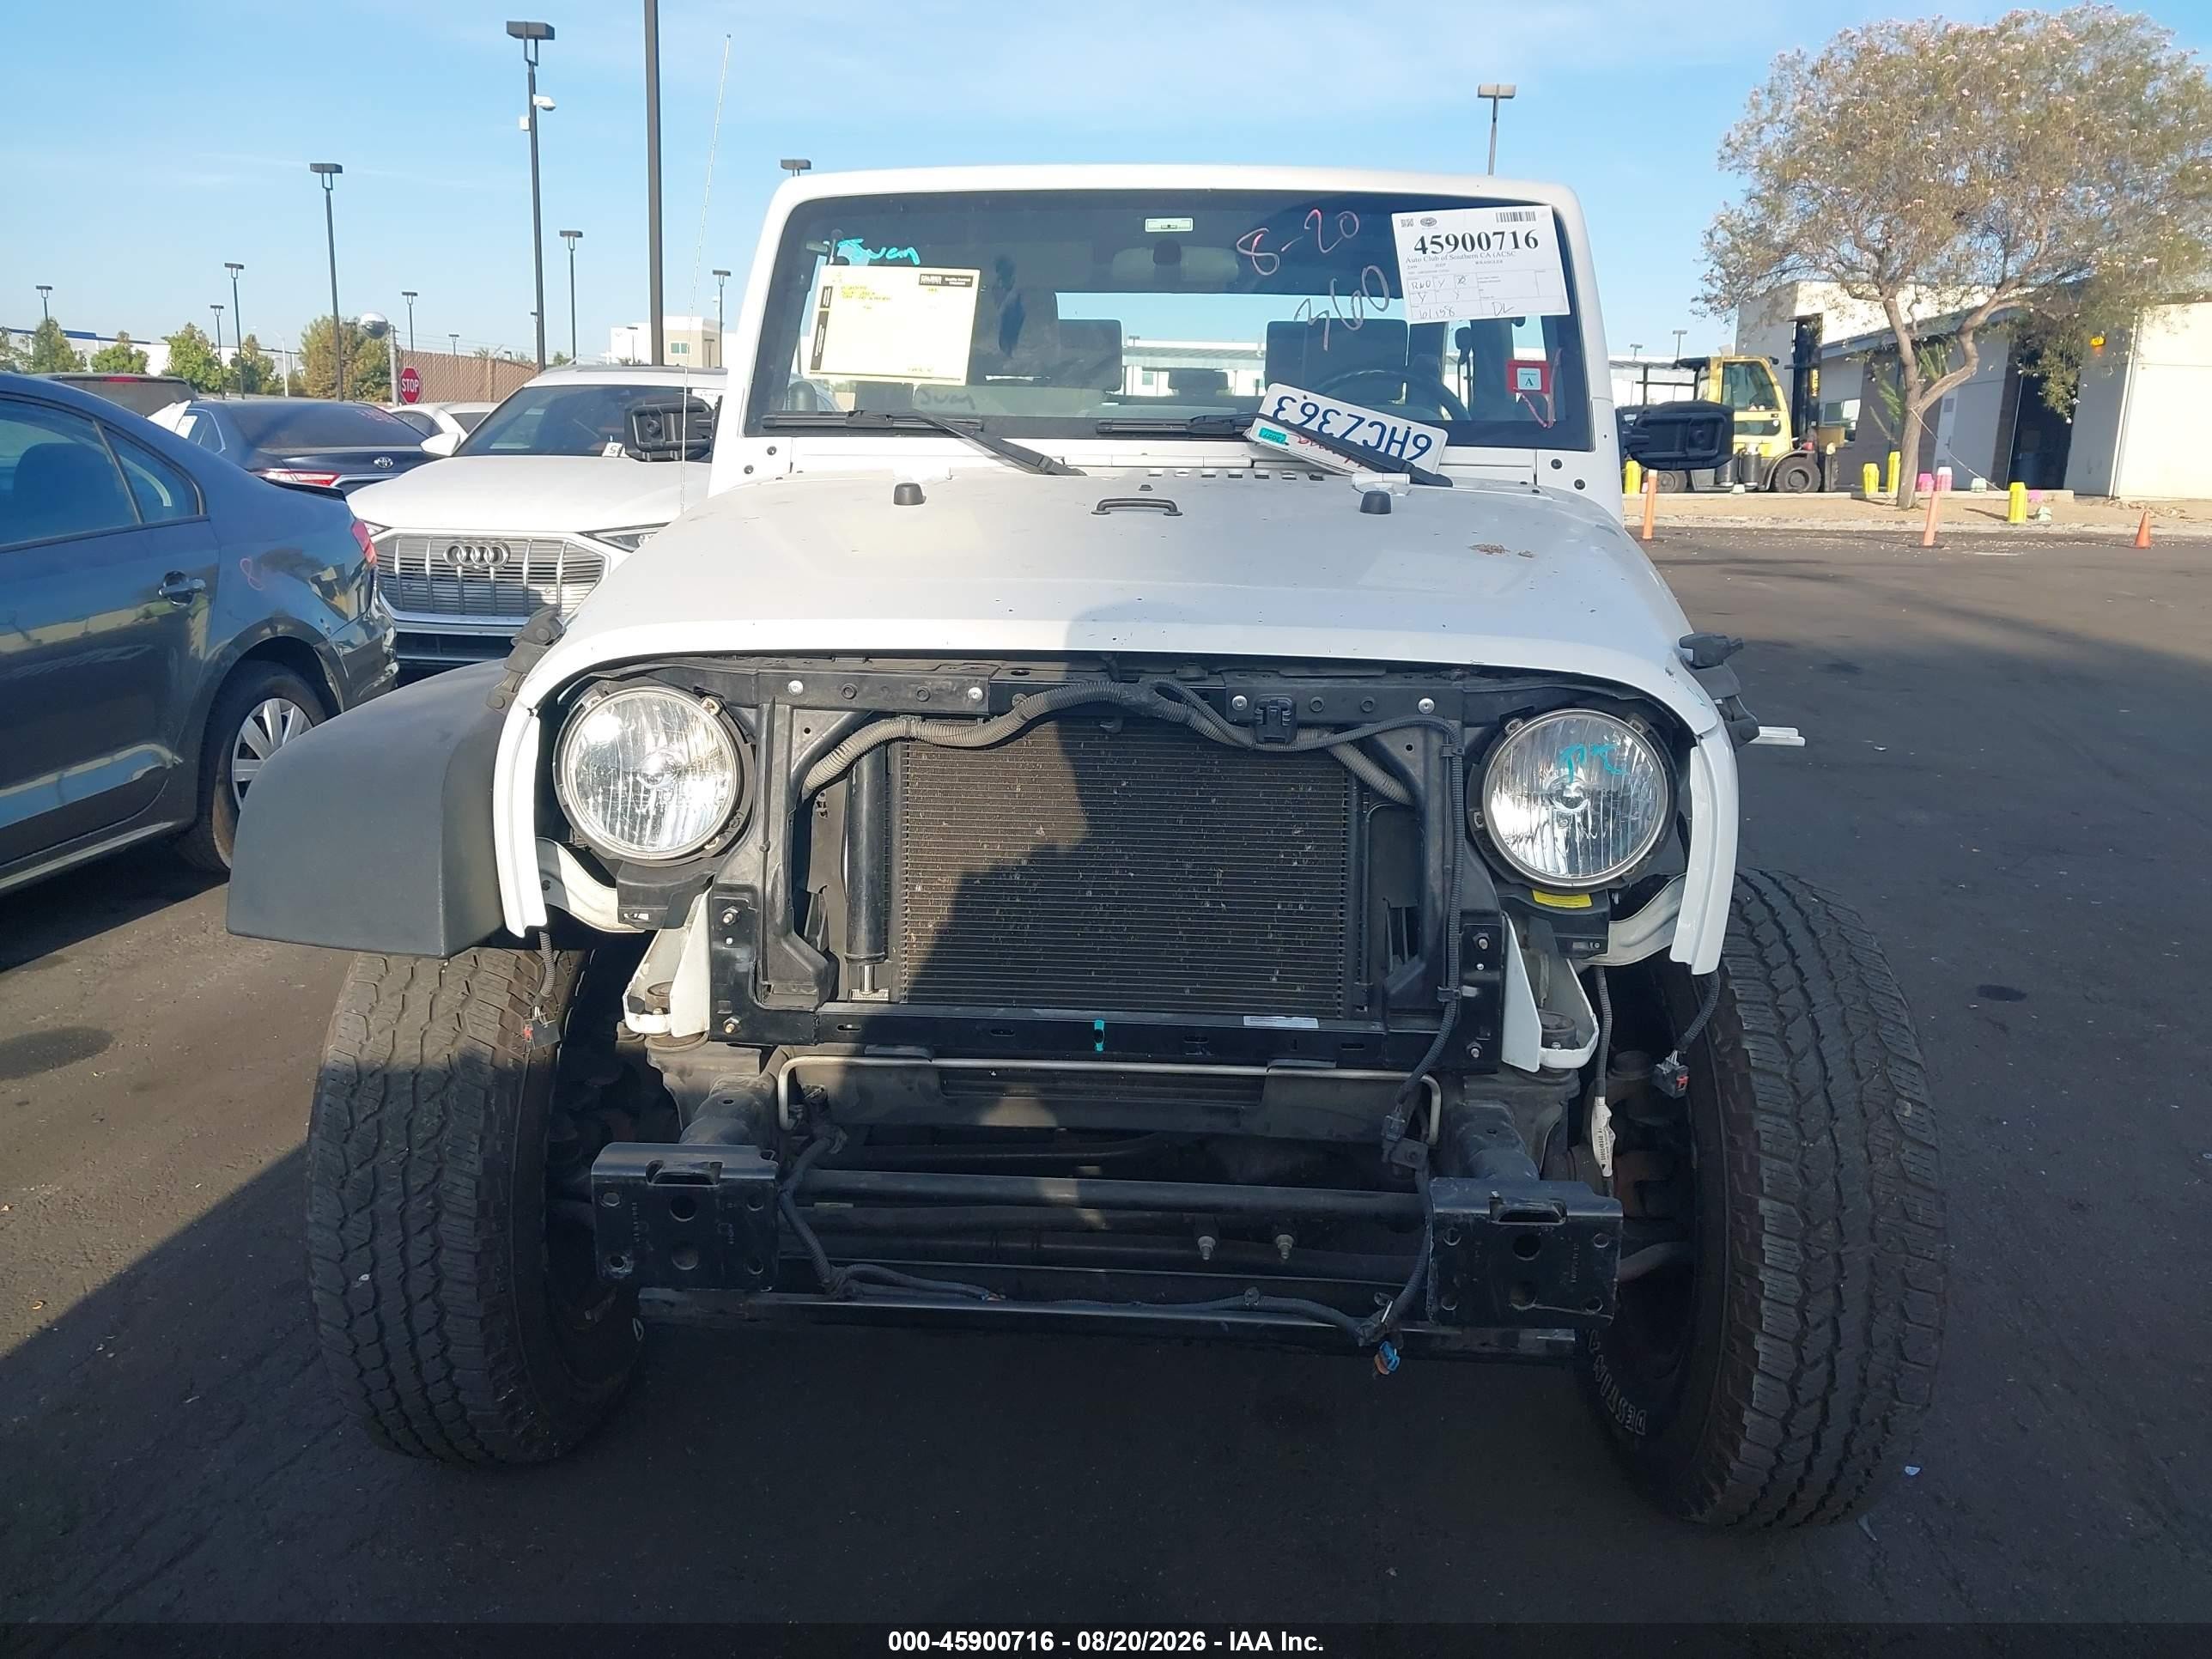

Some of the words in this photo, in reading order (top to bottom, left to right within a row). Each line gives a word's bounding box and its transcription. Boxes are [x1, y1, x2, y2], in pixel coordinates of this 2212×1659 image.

[1237, 210, 1360, 276] 8-20
[1414, 229, 1539, 255] 45900716
[401, 378, 419, 392] STOP
[1525, 378, 1534, 386] A
[1273, 396, 1432, 461] 6HCZ363
